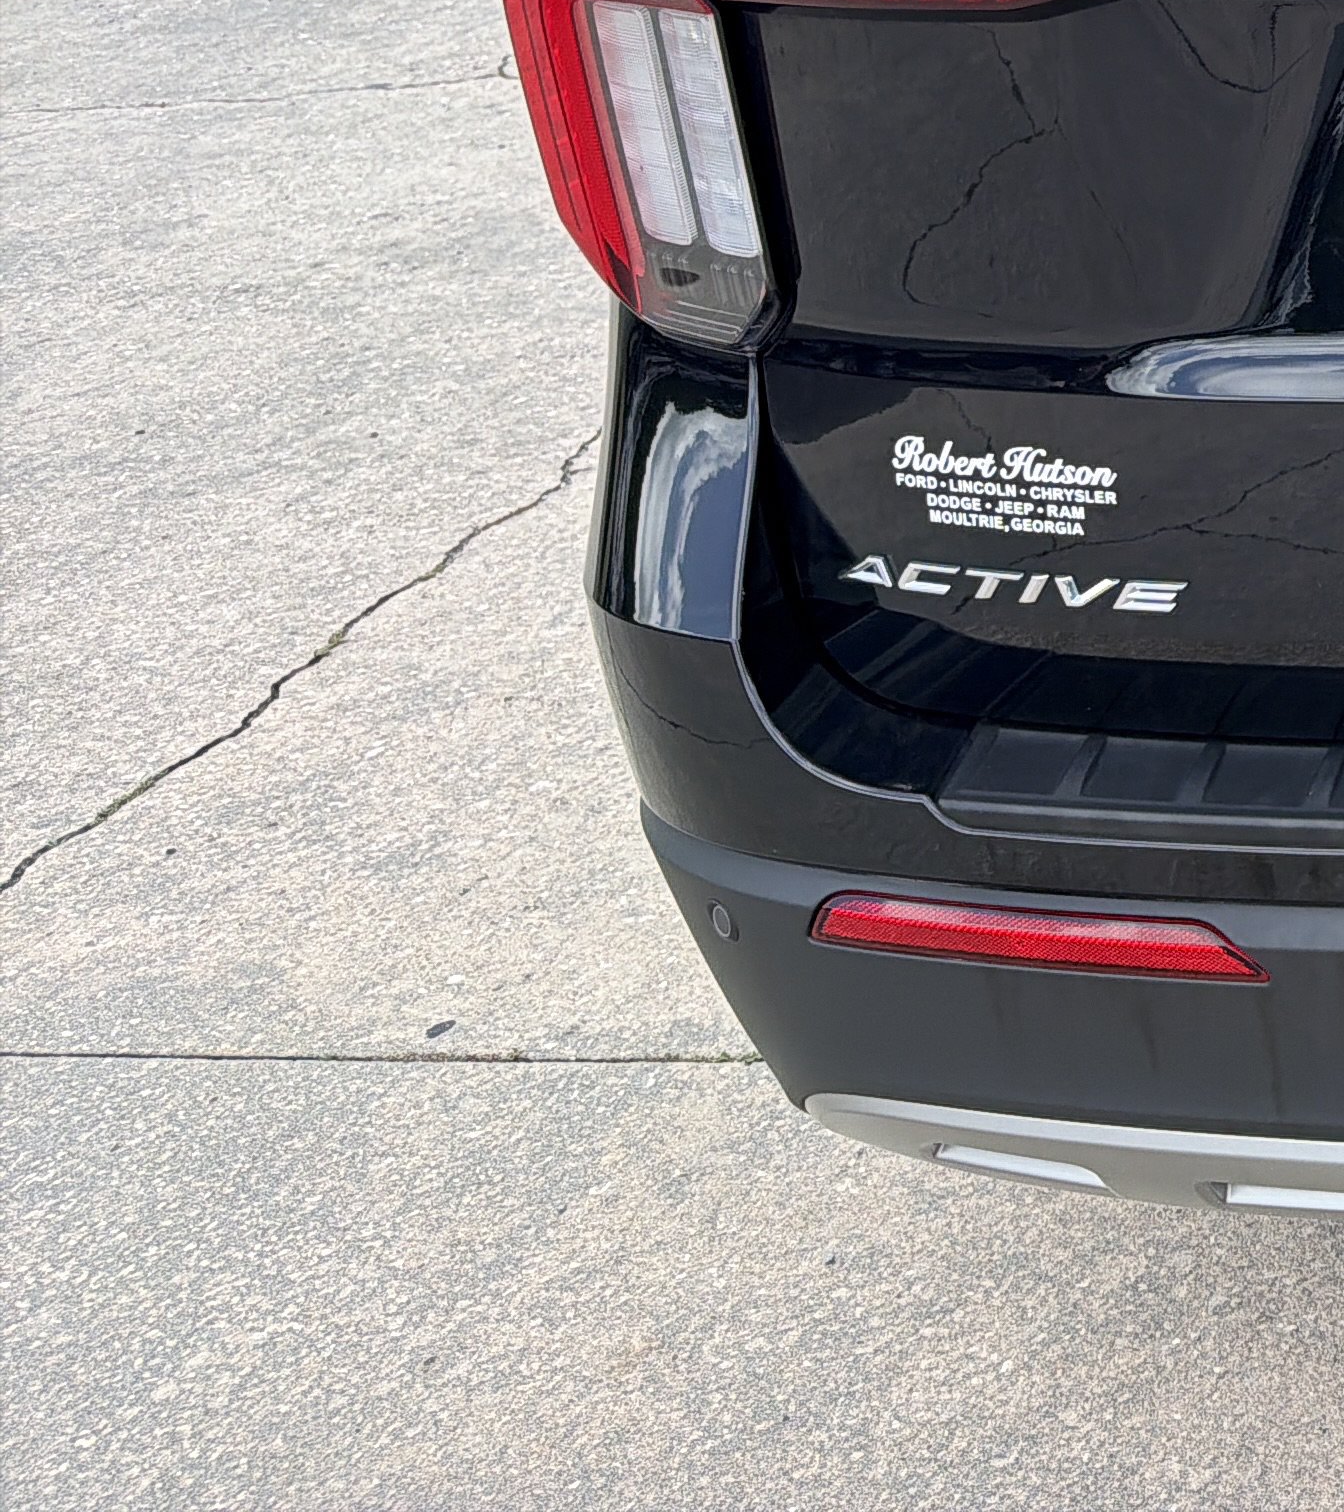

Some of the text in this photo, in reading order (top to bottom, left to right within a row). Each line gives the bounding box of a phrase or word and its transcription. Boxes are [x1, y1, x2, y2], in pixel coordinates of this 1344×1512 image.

[892, 435, 1118, 488] Robert Hutson
[895, 472, 1118, 505] FORD LINCOLN CHRYSLER
[926, 492, 1086, 520] DODGE JEEP RAM
[1010, 517, 1085, 537] GEORGIA
[838, 553, 1190, 614] ACTIVE
